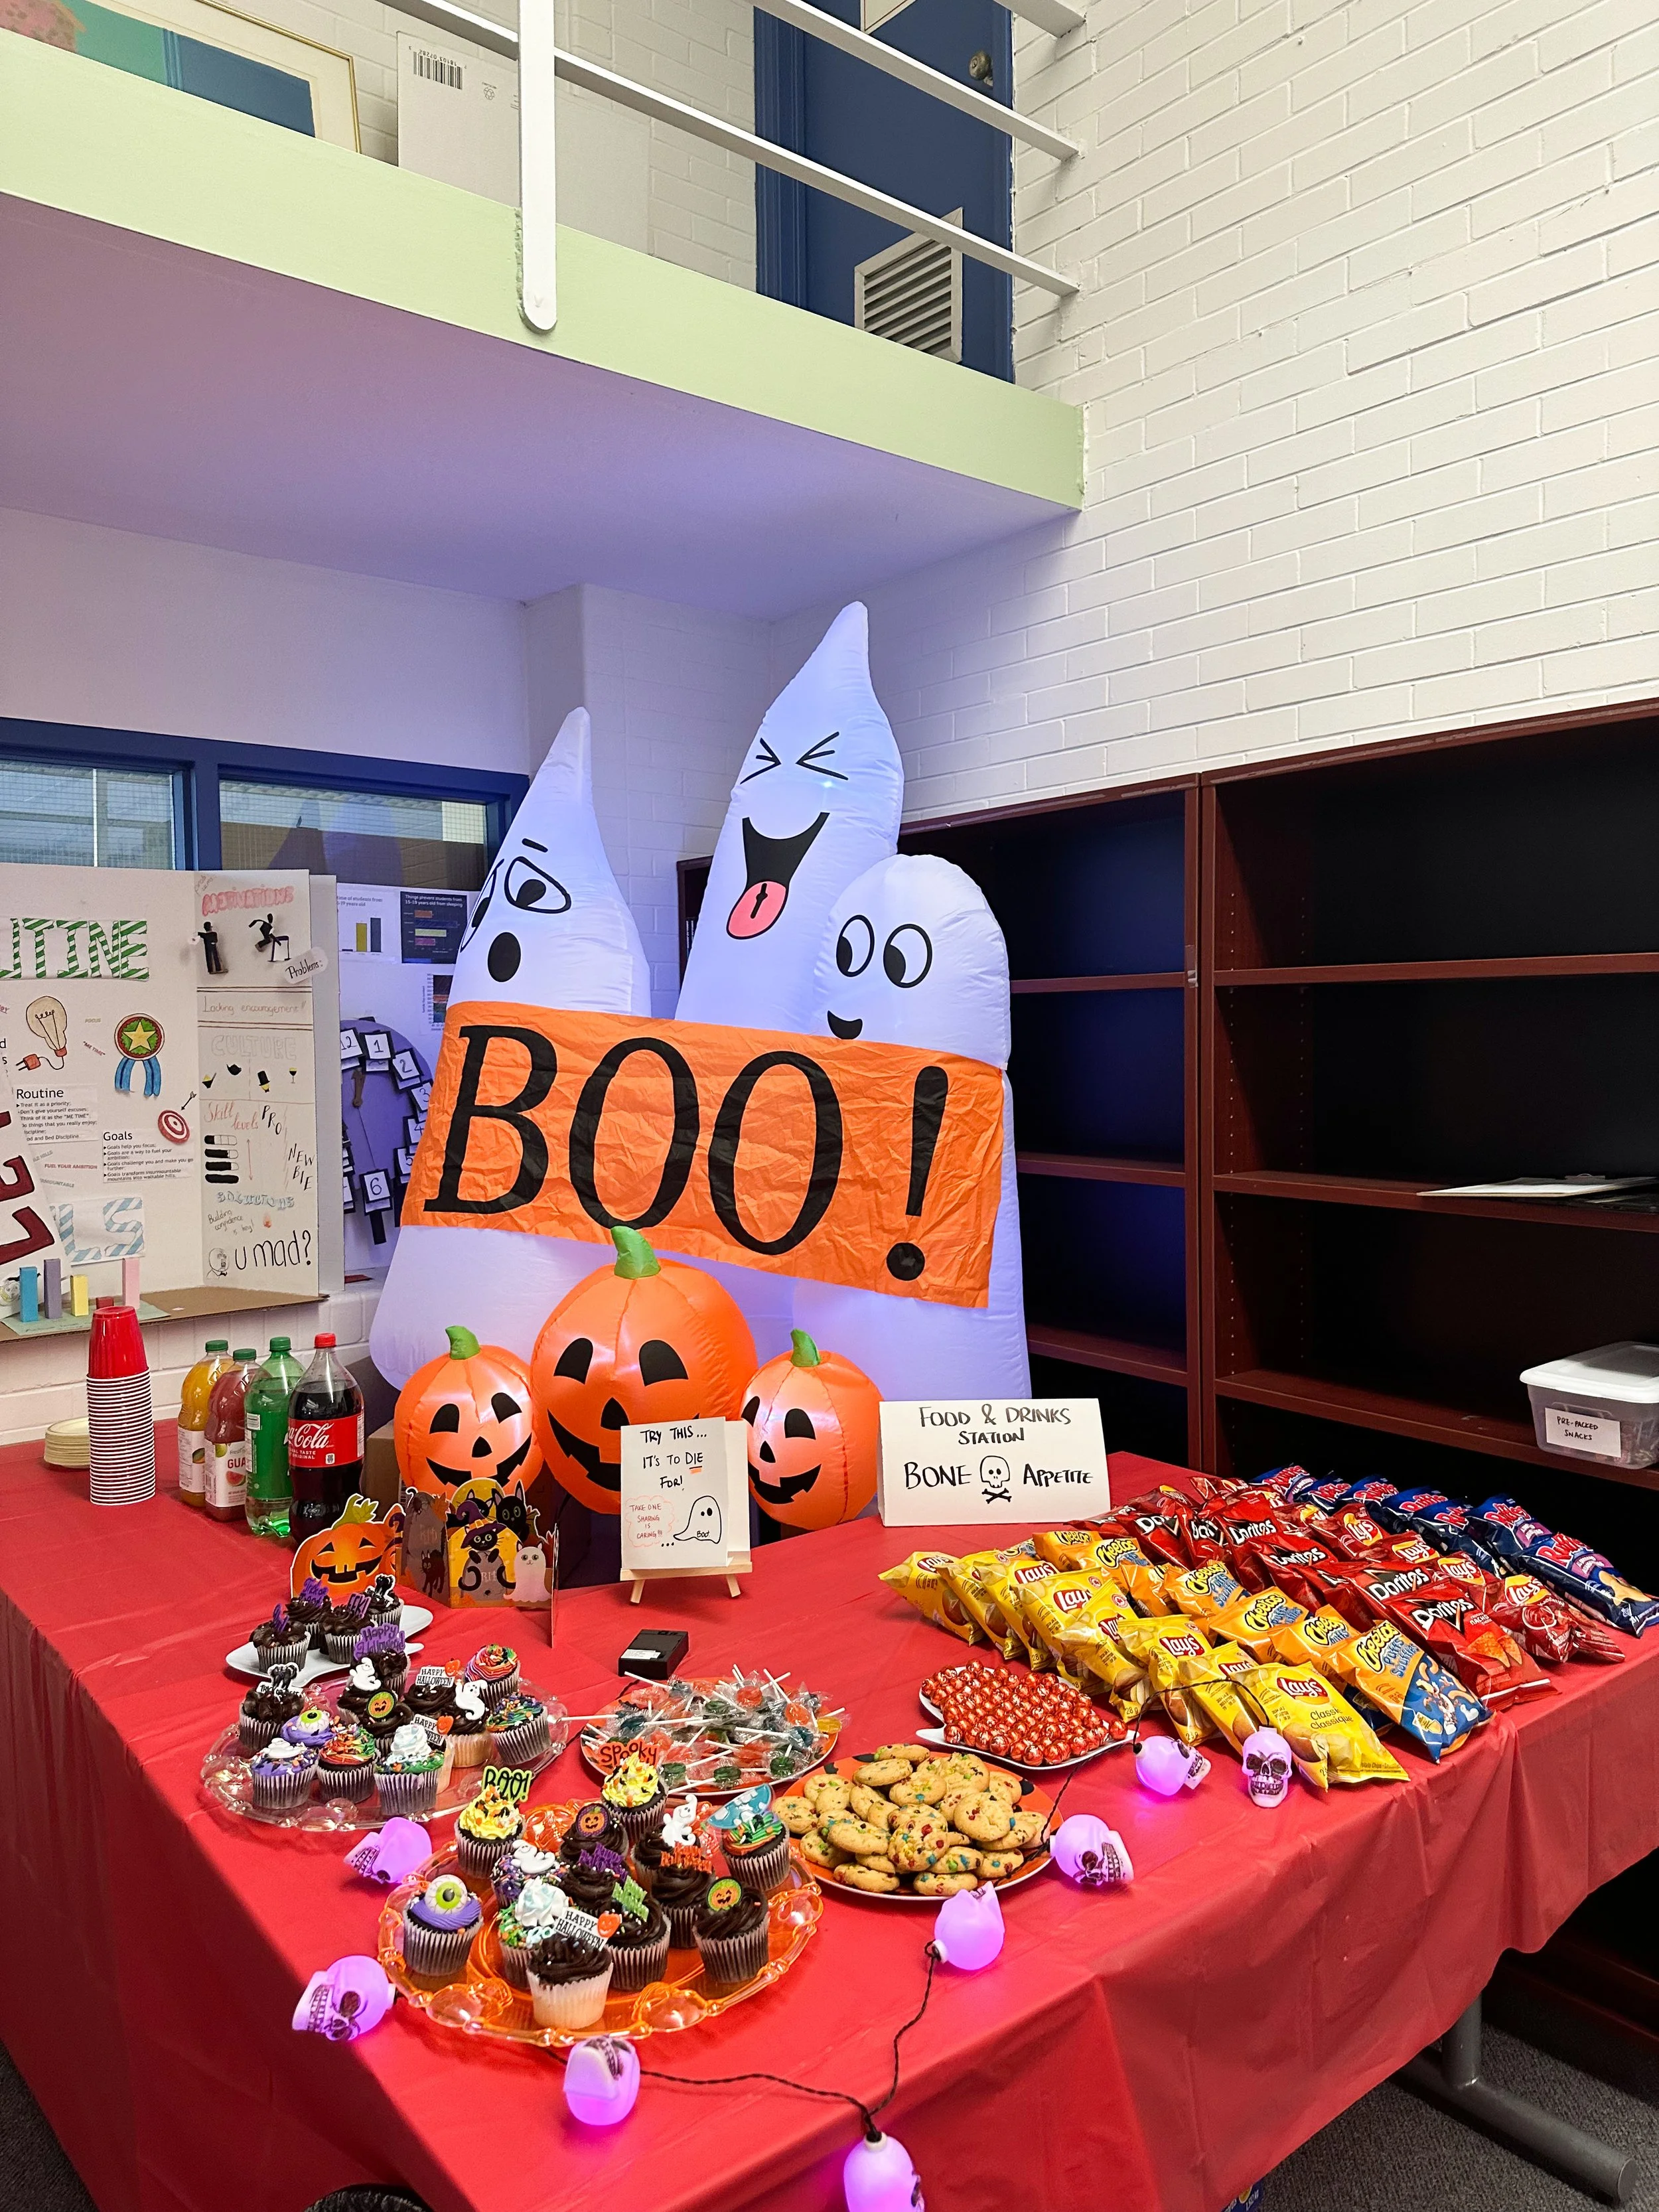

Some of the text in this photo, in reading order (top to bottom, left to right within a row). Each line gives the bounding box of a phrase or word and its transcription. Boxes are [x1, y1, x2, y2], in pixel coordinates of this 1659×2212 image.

[211, 1035, 297, 1061] CULTURE
[340, 1036, 356, 1051] 12
[374, 1040, 384, 1053] 1
[399, 1059, 412, 1073] 2
[17, 1088, 64, 1099] Routine
[419, 1088, 430, 1102] 3
[262, 1105, 282, 1135] PRO
[103, 1132, 133, 1141] Goals
[370, 1177, 382, 1195] 6
[208, 1210, 232, 1224] Building
[253, 1230, 311, 1267] mad?
[918, 1404, 1071, 1428] FOOD & DRINKS
[1557, 1416, 1598, 1430] PRE-PACKED
[640, 1430, 662, 1445] TRY
[958, 1428, 1025, 1445] STATION
[1564, 1430, 1593, 1440] SNACKS
[666, 1455, 680, 1465] TO
[685, 1452, 703, 1465] DIE
[660, 1475, 685, 1491] FOR!
[904, 1461, 972, 1489] BONE
[1228, 1519, 1277, 1544] Doritos
[1096, 1538, 1137, 1569] Cheetos
[1185, 1562, 1227, 1595] Cheetos
[1444, 1561, 1477, 1580] Lay's
[1369, 1568, 1429, 1601] Doritos
[1244, 1593, 1285, 1631] Cheetos
[1412, 1598, 1475, 1630] Doritos
[362, 1625, 397, 1641] Happy
[1162, 1634, 1199, 1657] Lay's
[1356, 1621, 1401, 1674] Cheetos
[1382, 1638, 1404, 1665] Puffs
[417, 1676, 452, 1686] HALLOWEEN
[1279, 1678, 1321, 1697] Lay's
[414, 1718, 437, 1731] HAPPY
[1311, 1715, 1354, 1730] Classique
[484, 1768, 531, 1800] BOO!
[565, 1911, 597, 1931] HAPPY
[555, 1919, 605, 1949] HALLOWEEN
